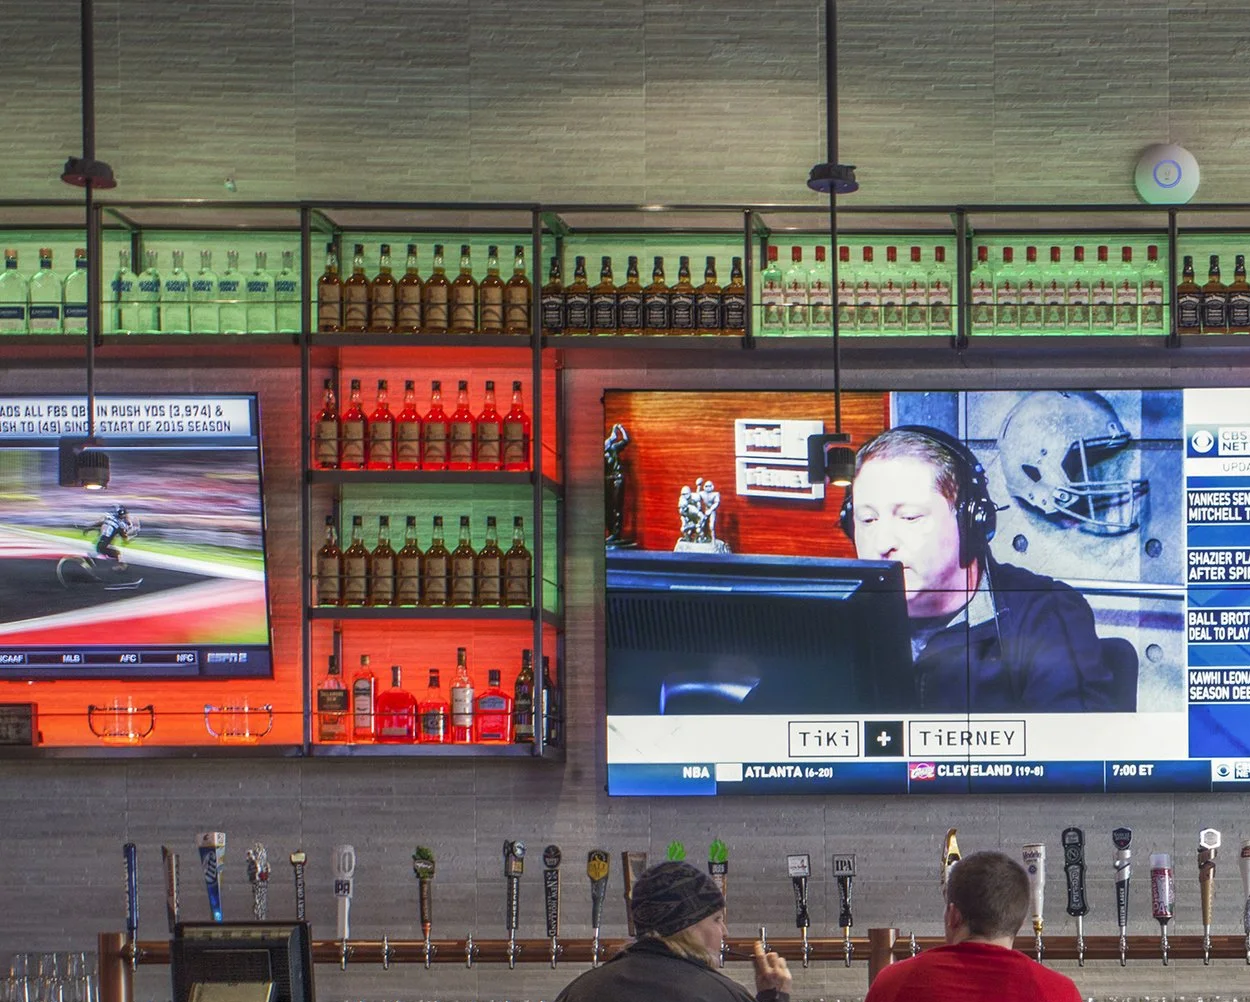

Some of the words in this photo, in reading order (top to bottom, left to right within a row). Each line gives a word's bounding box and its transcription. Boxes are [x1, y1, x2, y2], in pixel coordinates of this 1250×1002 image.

[25, 405, 43, 417] ALL
[47, 405, 68, 417] FBS
[71, 405, 88, 418] QB
[97, 405, 107, 416] IN
[111, 405, 140, 416] RUSH
[215, 405, 223, 416] &
[64, 421, 96, 432] SINC
[100, 420, 134, 432] START
[138, 420, 151, 432] OF
[155, 420, 184, 432] 2015
[188, 420, 231, 432] SEASON
[1222, 430, 1247, 440] CBS
[1188, 492, 1231, 506] YANKEES
[1188, 507, 1242, 520] MITCHELL
[1188, 552, 1232, 564] SHAZIER
[1189, 568, 1226, 580] AFTER
[1189, 612, 1217, 625] BALL
[1189, 627, 1212, 640] DEAL
[1214, 627, 1225, 640] TO
[1227, 627, 1250, 640] PLAY
[120, 654, 136, 662] AFC
[176, 654, 194, 662] NFC
[1190, 672, 1220, 684] KAWHI
[1190, 686, 1230, 700] SEASON
[683, 767, 710, 778] NBA
[744, 766, 802, 778] ATLANTA
[805, 767, 833, 779] (6-20)
[937, 765, 1014, 776] CLEVELAND
[1015, 766, 1044, 777] (19-8)
[1112, 765, 1136, 776] 7:00
[1138, 765, 1154, 776] ET
[836, 860, 852, 872] IPA
[296, 898, 305, 921] NGRY
